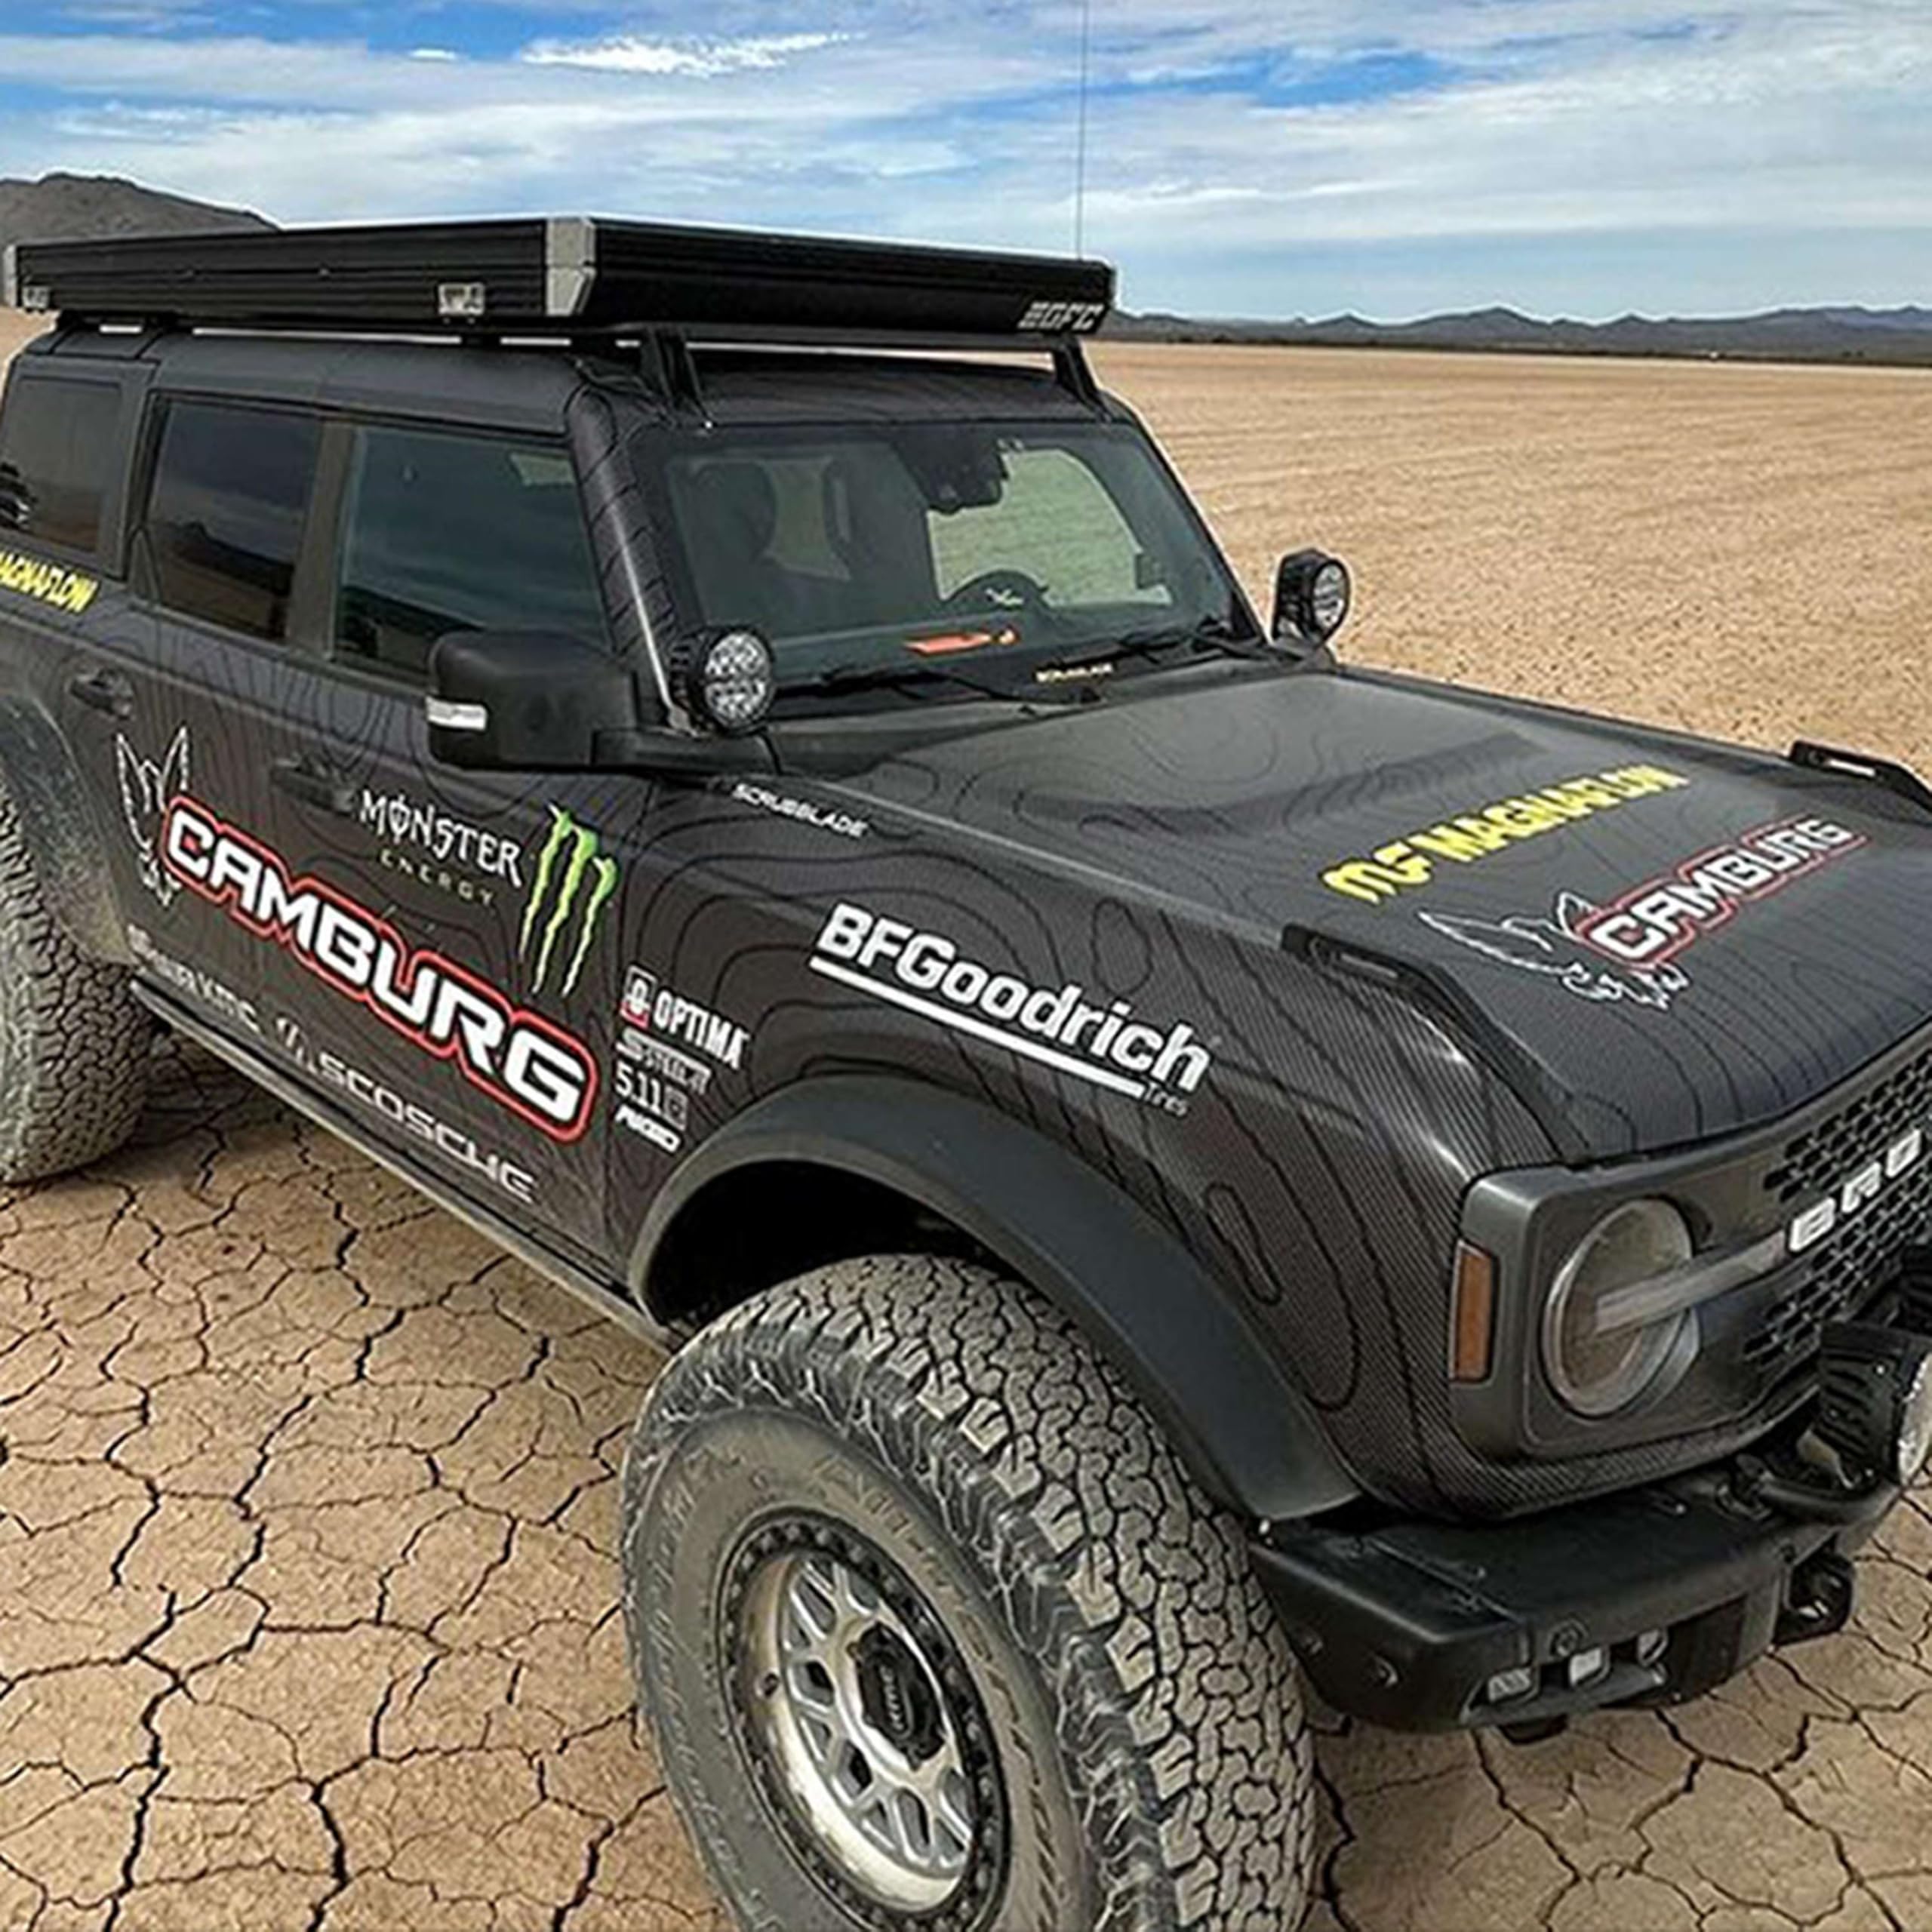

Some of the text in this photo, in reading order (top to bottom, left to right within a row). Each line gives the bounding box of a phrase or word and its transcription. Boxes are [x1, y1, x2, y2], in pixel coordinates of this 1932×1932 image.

[0, 550, 99, 613] AGNAFLOW
[358, 789, 521, 888] MONSTER
[1407, 764, 1690, 862] MAGNAFLOW
[380, 849, 494, 906] ENERGY
[1586, 818, 1856, 960] CAMBURG
[164, 804, 590, 1126] CAMBURG
[815, 903, 1211, 1092] BFGoodrich
[654, 989, 746, 1070] OPTIMA
[319, 1052, 537, 1204] SCOSCHE
